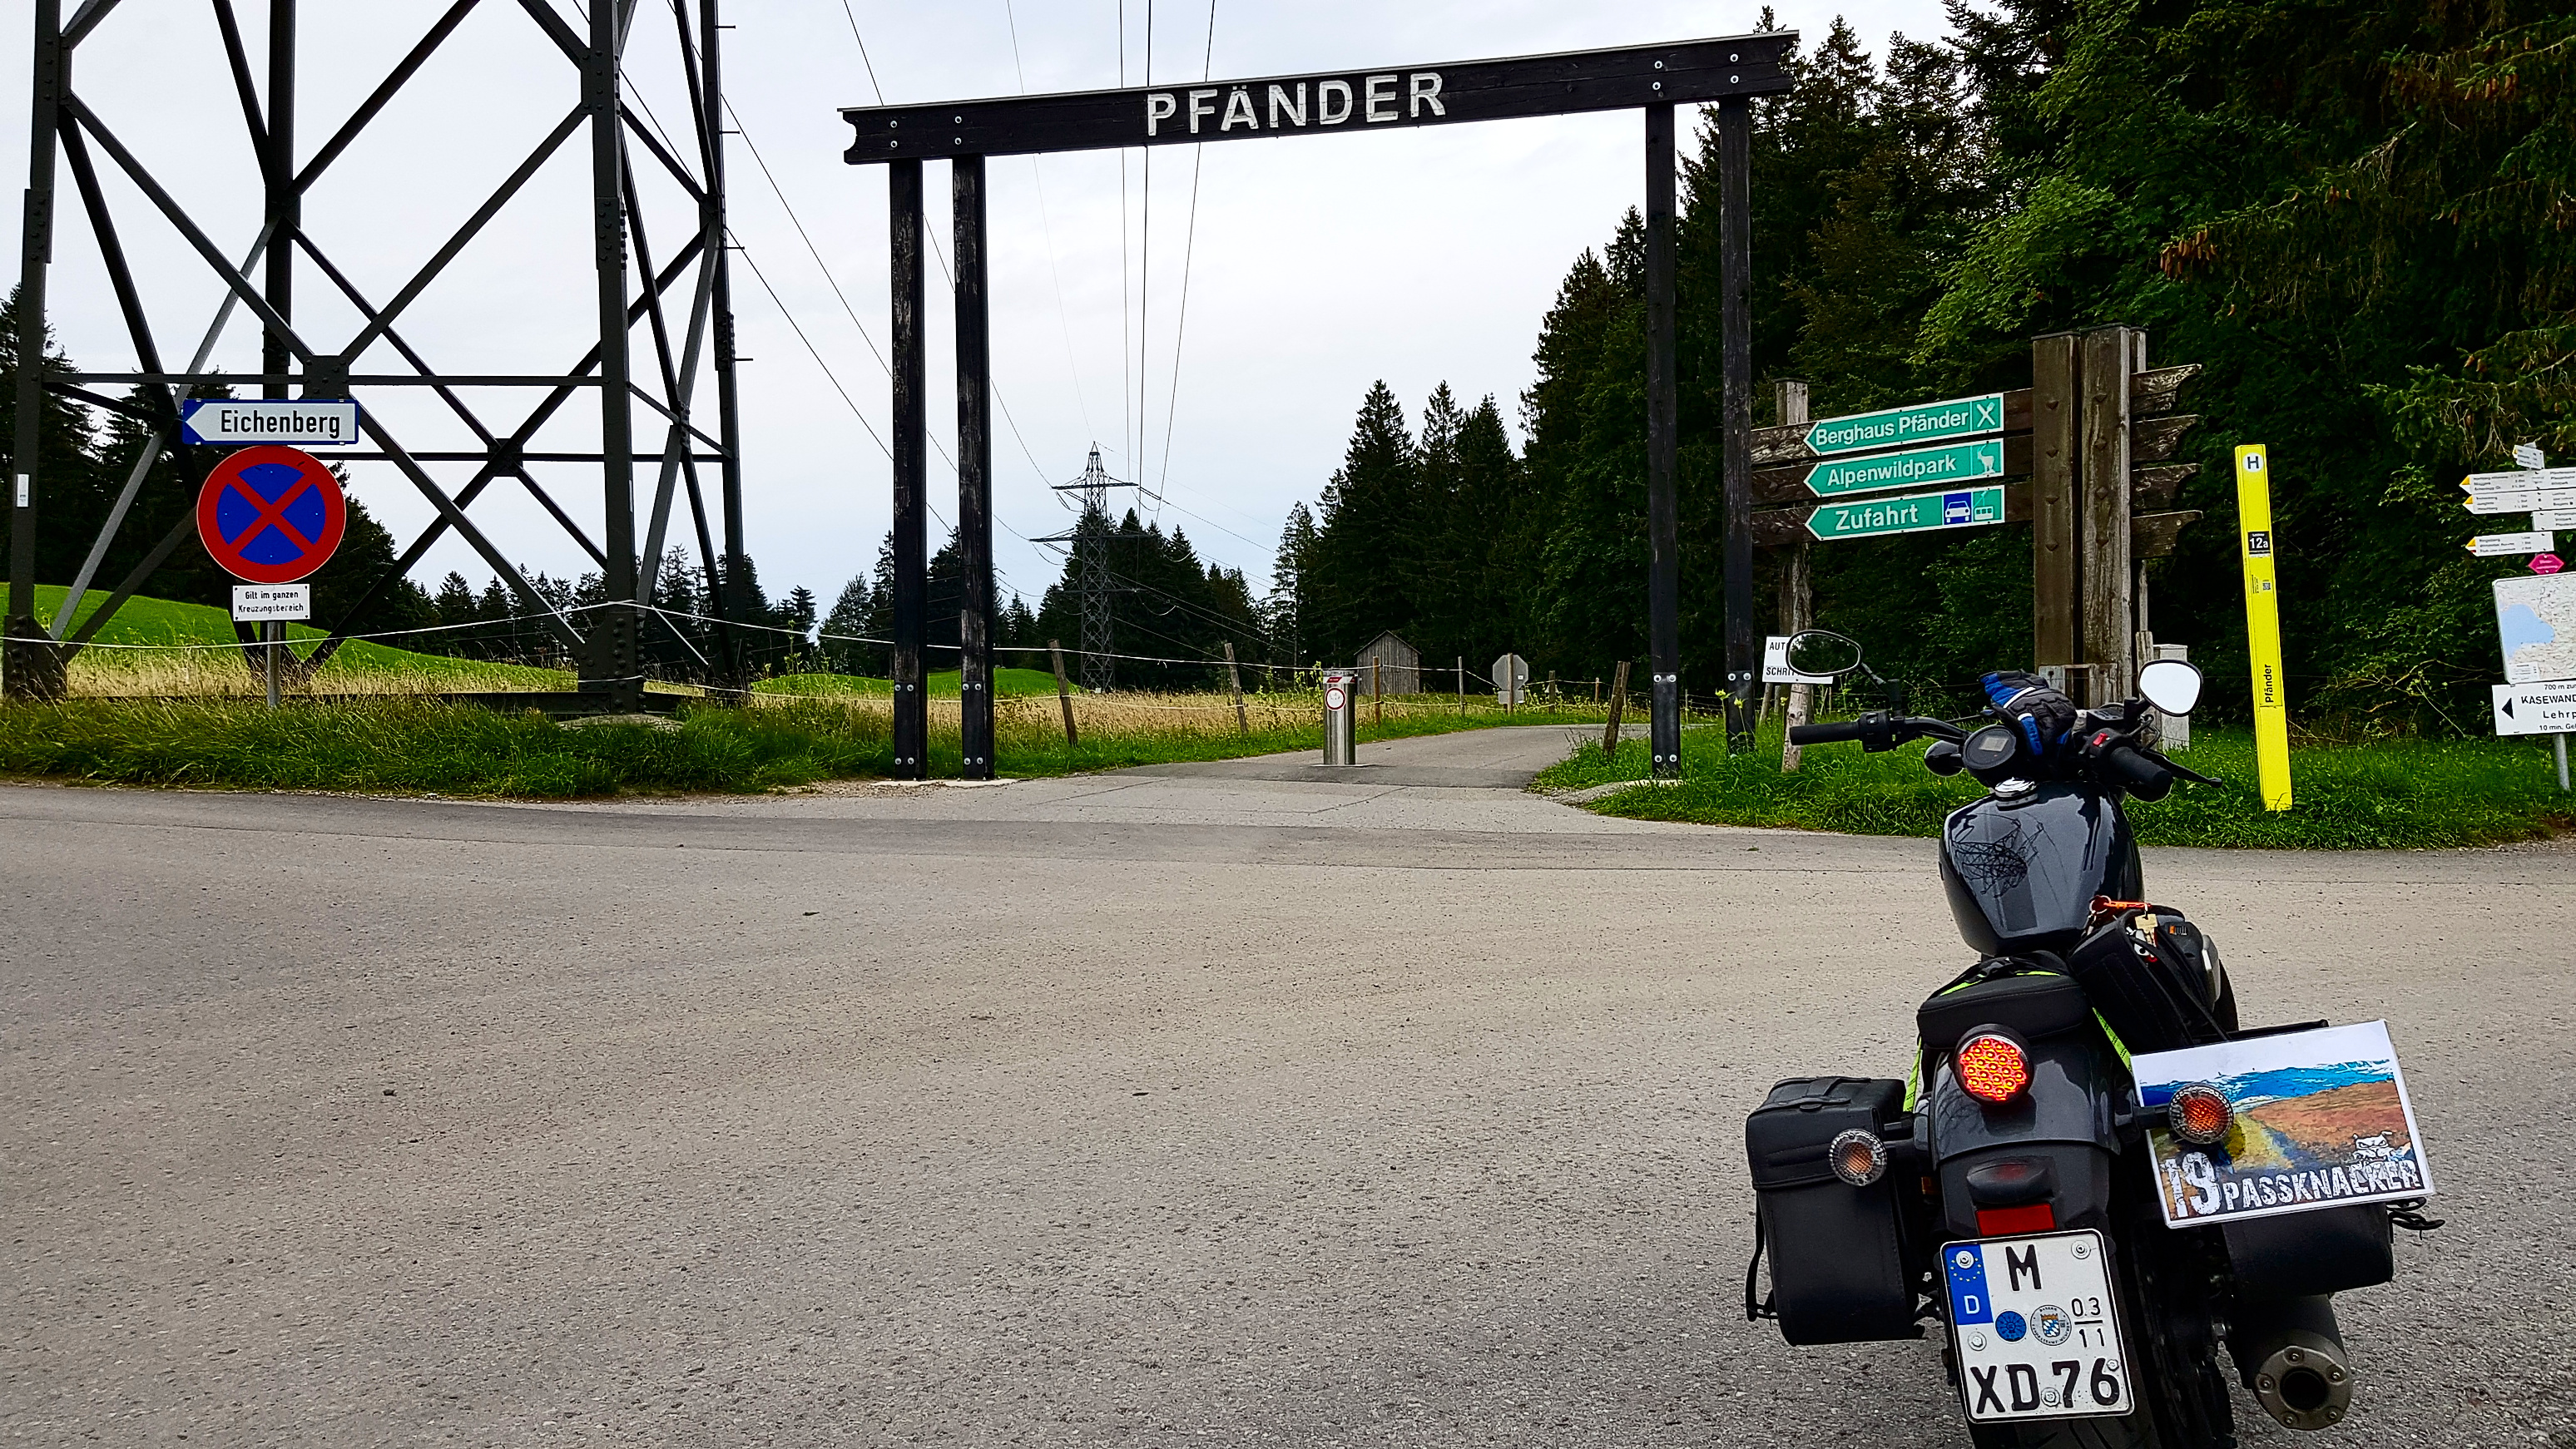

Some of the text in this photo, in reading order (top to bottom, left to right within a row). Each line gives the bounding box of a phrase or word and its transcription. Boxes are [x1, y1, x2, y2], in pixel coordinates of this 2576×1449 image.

[1147, 72, 1446, 136] PFÄNDER
[220, 409, 340, 439] Eichenberg
[1816, 410, 1969, 446] Berghaus Pfänder
[1827, 454, 1957, 488] Alpenwildpark
[2247, 455, 2260, 469] H
[1835, 503, 1919, 532] Zufahrt
[2249, 537, 2269, 549] 12a
[245, 591, 299, 601] Gilt im ganzen
[238, 603, 304, 615] Kreuzungsbereich
[1769, 641, 1788, 650] AUT
[1765, 666, 1800, 676] SCHRI
[2263, 664, 2274, 702] Pfänder
[2223, 1160, 2422, 1211] PASSKNACKER
[2005, 1244, 2042, 1291] M
[1964, 1295, 1980, 1314] D
[2071, 1297, 2101, 1317] 03
[2078, 1328, 2105, 1348] 11
